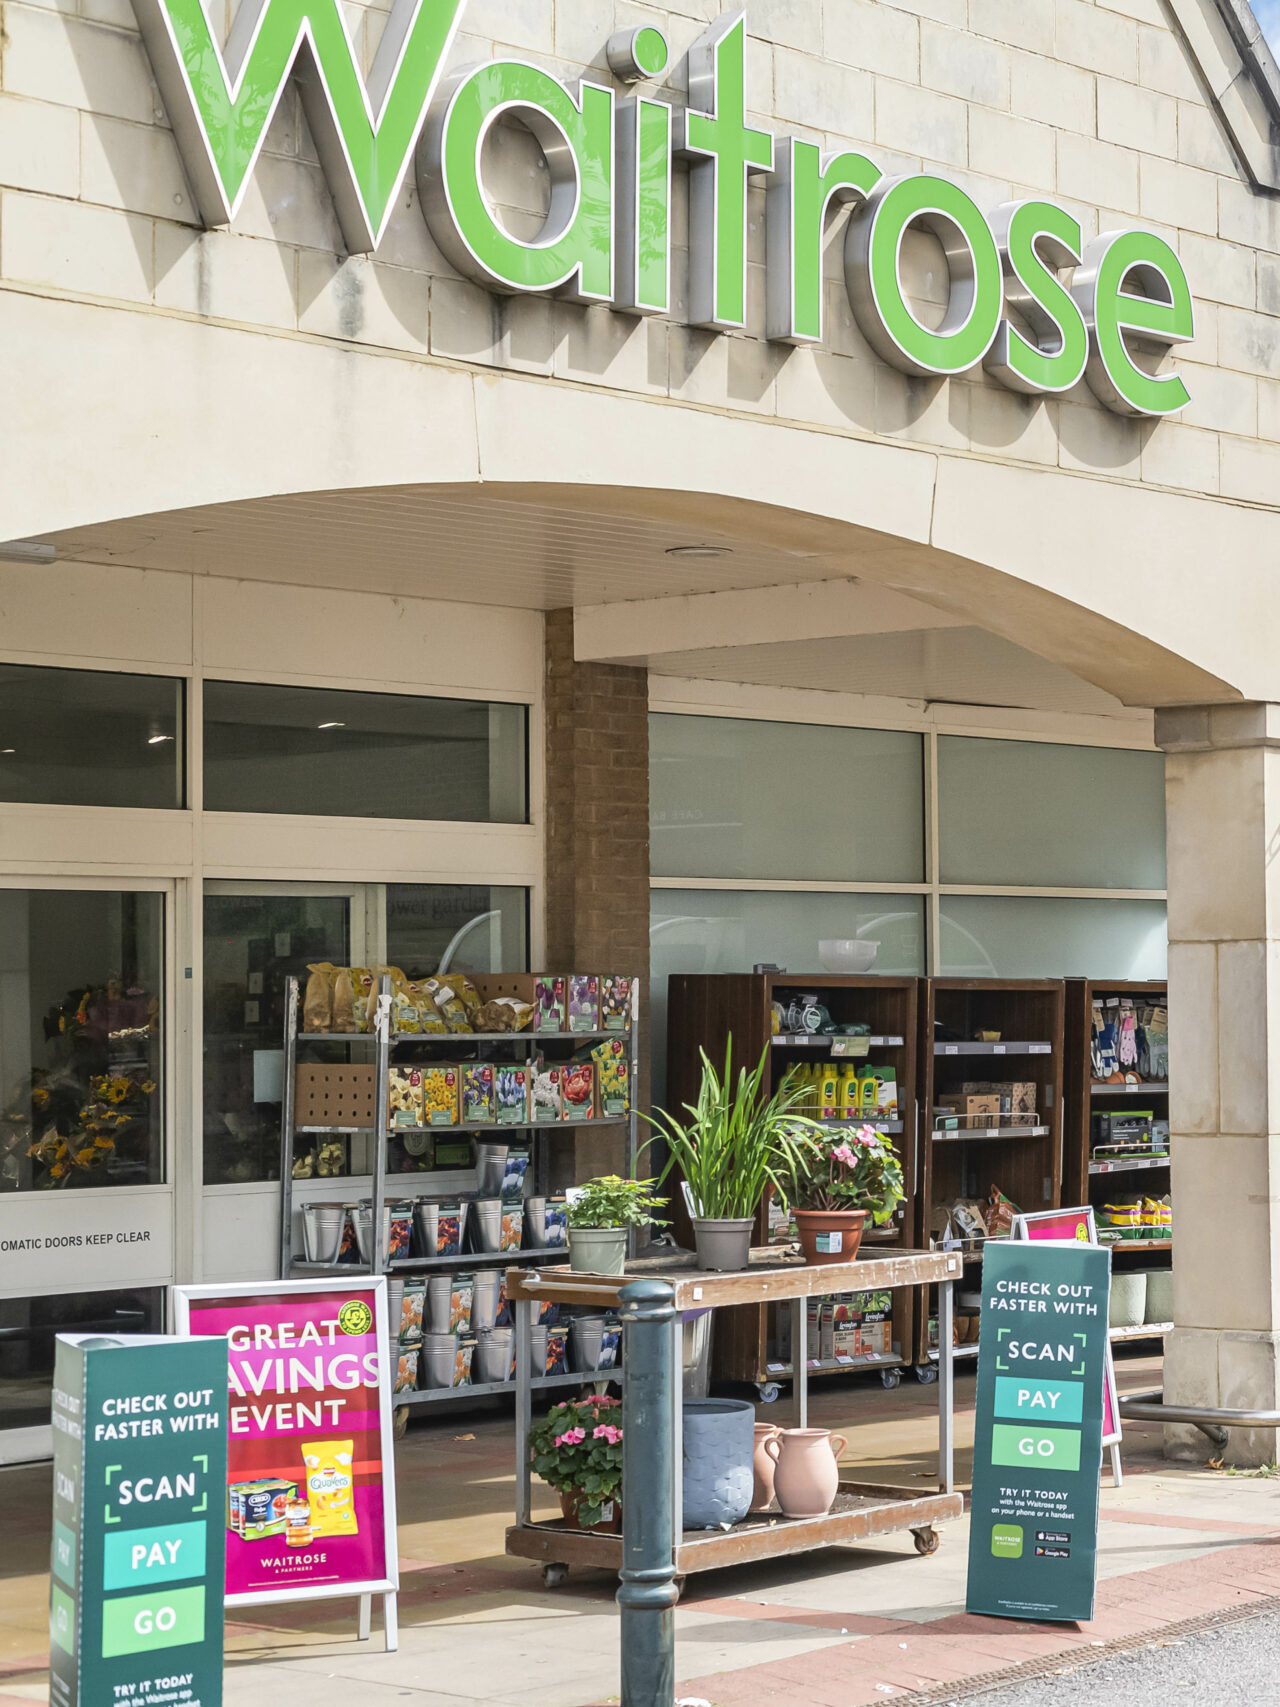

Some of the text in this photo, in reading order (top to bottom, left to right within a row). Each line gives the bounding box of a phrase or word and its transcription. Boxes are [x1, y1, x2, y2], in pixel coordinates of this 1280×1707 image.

[135, 0, 1196, 418] Waitrose
[0, 1230, 151, 1252] OMATIC DOORS KEEP CLEAR
[996, 1279, 1093, 1298] CHECK OUT
[989, 1297, 1098, 1317] FASTER WITH
[226, 1319, 340, 1352] GREAT
[1008, 1341, 1075, 1363] SCAN
[227, 1352, 380, 1397] AVINGS
[102, 1389, 214, 1416] CHECK OUT
[1017, 1389, 1061, 1409] PAY
[94, 1412, 219, 1442] FASTER WITH
[230, 1399, 347, 1434] EVENT
[1018, 1437, 1055, 1457] GO
[118, 1472, 196, 1506] SCAN
[309, 1476, 349, 1490] Quavers
[1000, 1487, 1069, 1500] TRY IT TODAY
[1016, 1509, 1035, 1517] phone
[1050, 1511, 1075, 1520] handset
[1026, 1500, 1055, 1509] Waitrose
[131, 1539, 182, 1570] PAY
[260, 1552, 328, 1568] WAITROSE
[133, 1606, 177, 1635] GO
[113, 1673, 194, 1698] TRY IT TODAY
